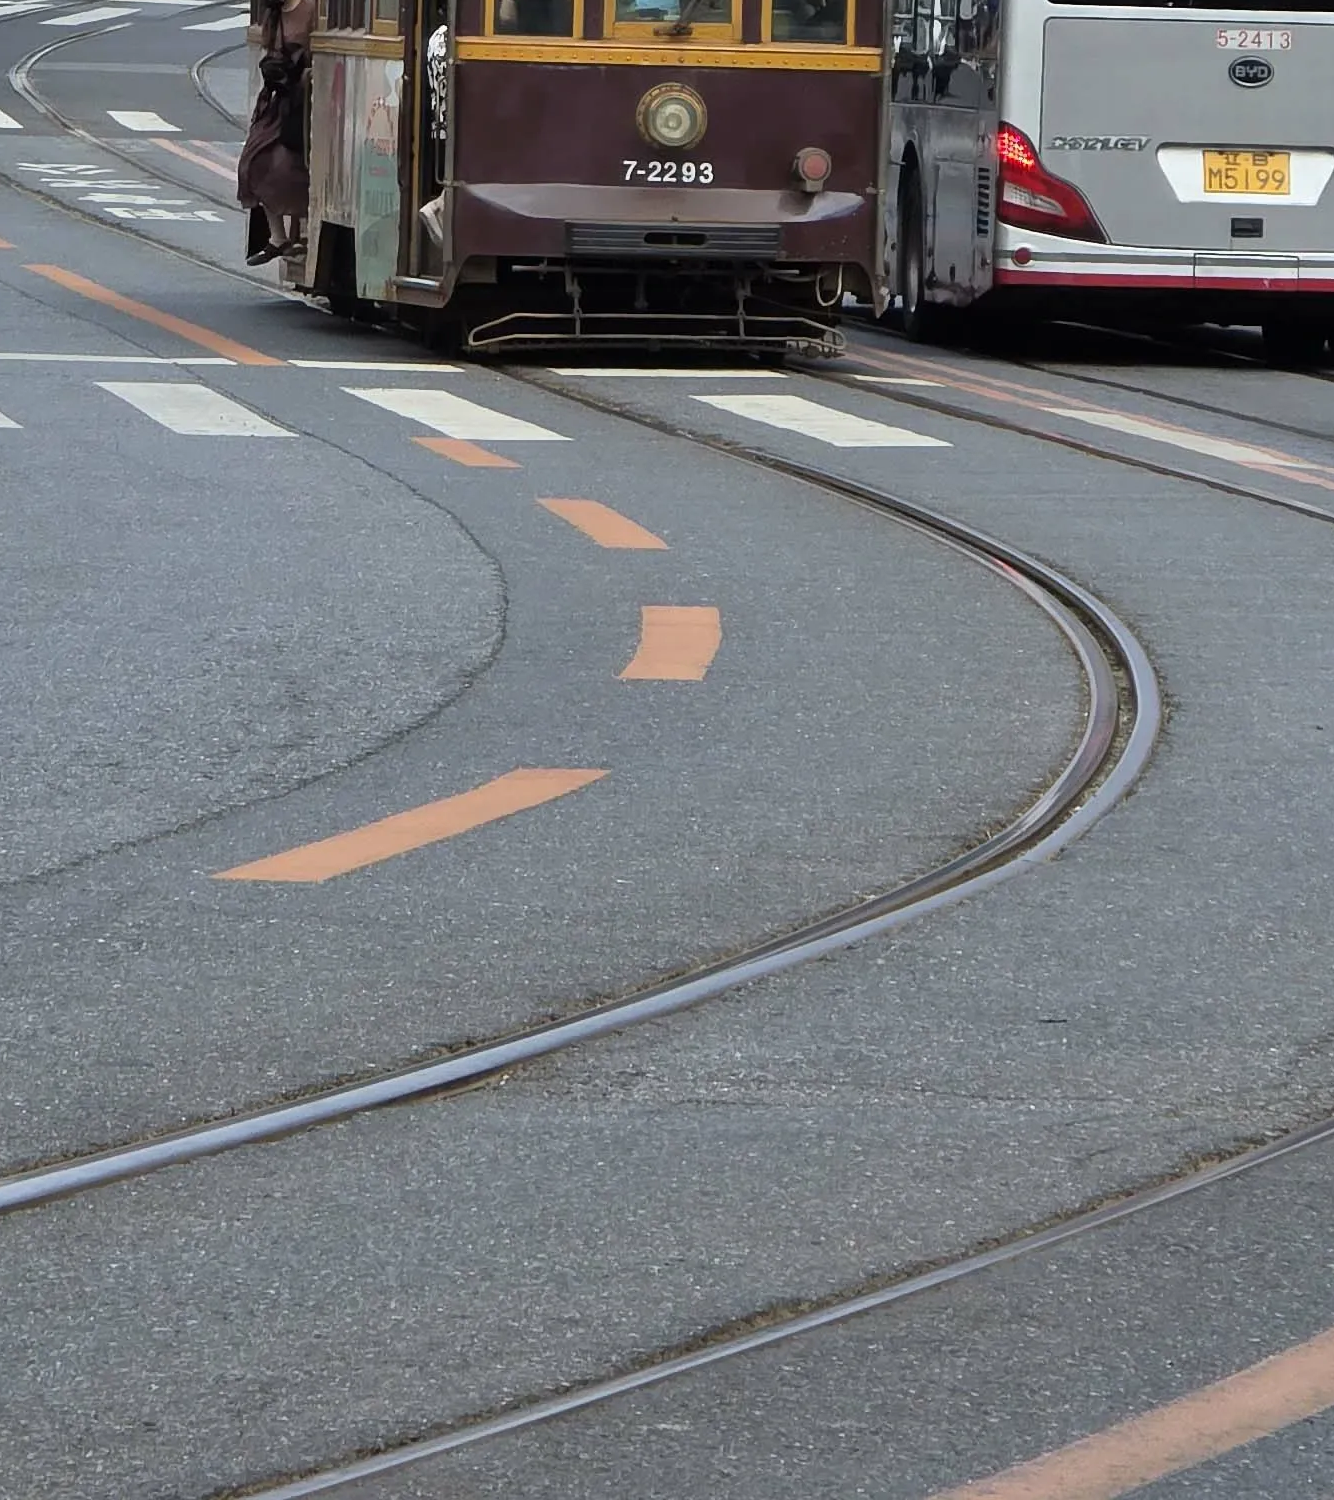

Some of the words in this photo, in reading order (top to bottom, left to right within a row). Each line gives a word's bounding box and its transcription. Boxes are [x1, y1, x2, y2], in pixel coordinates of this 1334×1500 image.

[1217, 29, 1291, 49] 5-2413
[1235, 65, 1269, 78] BYD
[623, 160, 714, 184] 7-2293
[1208, 168, 1285, 190] M5199
